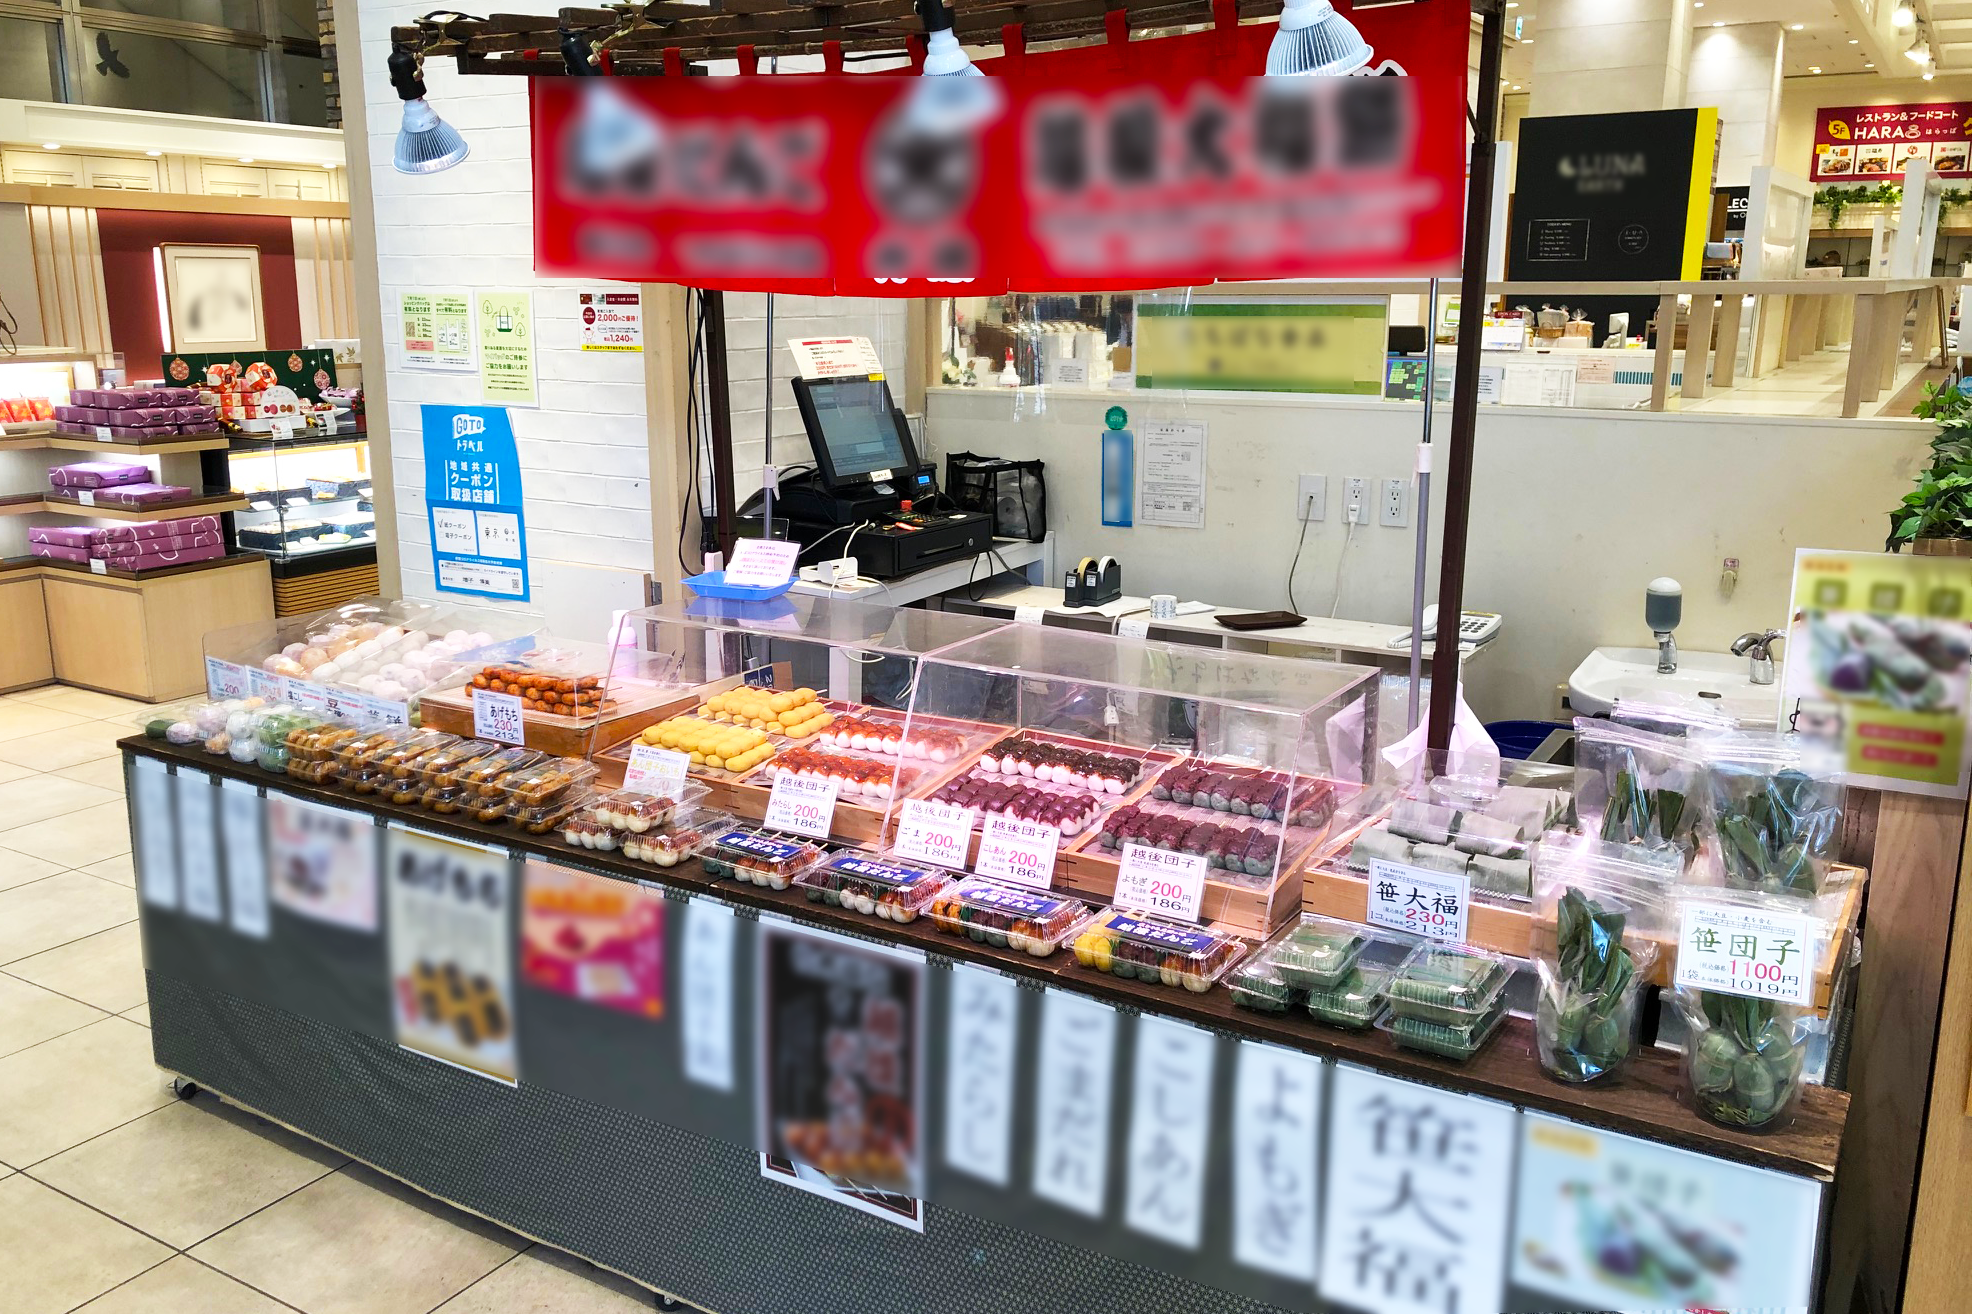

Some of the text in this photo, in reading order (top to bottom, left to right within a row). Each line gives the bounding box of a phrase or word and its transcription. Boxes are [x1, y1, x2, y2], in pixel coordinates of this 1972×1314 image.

[1832, 124, 1846, 135] 5F
[456, 439, 484, 452] トラベル
[449, 460, 493, 473] 地域共通
[450, 472, 494, 487] クーポン
[450, 487, 495, 504] 取扱店舗
[445, 532, 472, 541] 電子クーポン
[490, 704, 518, 722] あげもち
[780, 776, 831, 792] 越後団子
[771, 799, 792, 810] みたらし
[910, 803, 966, 820] 越後団子
[901, 827, 920, 837] ごま
[991, 820, 1051, 839] 越後団子
[983, 844, 1007, 856] こしあん
[1130, 848, 1197, 868] 越後団子
[1121, 874, 1148, 887] よもぎ
[1375, 880, 1460, 915] 笹大福
[1405, 908, 1458, 929] 230円
[1405, 920, 1458, 938] 213円
[1689, 926, 1801, 966] 笹団子
[1729, 959, 1799, 986] 1100円
[1729, 978, 1799, 997] 1019円
[1141, 1037, 1193, 1226] こしあん
[1253, 1063, 1303, 1260] よもぎ
